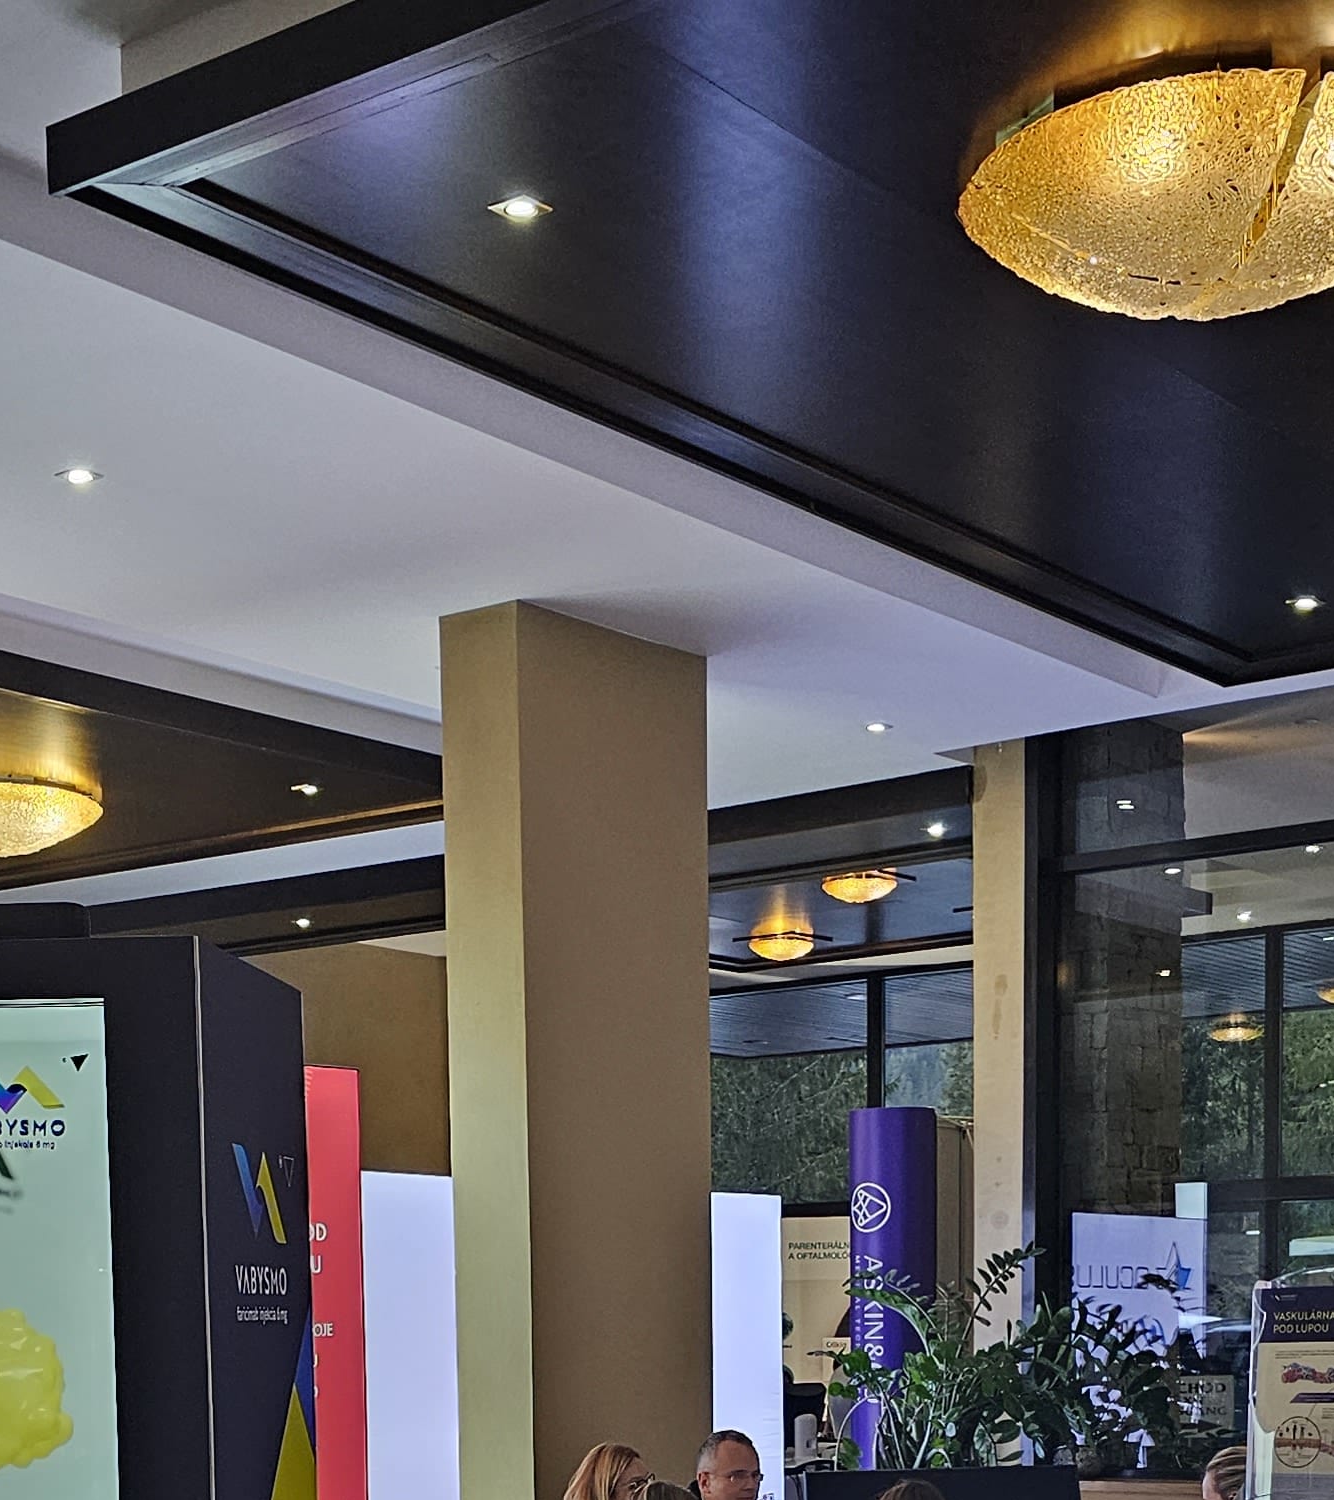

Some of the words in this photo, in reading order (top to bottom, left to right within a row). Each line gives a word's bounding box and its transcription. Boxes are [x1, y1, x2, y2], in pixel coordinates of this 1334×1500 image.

[788, 1241, 849, 1250] PARENTERÁLN
[788, 1252, 794, 1260] A
[796, 1251, 850, 1260] OFTALMOLÓ
[235, 1265, 288, 1295] VABYSMO
[1273, 1324, 1294, 1334] POD
[1295, 1323, 1329, 1333] LUPOU
